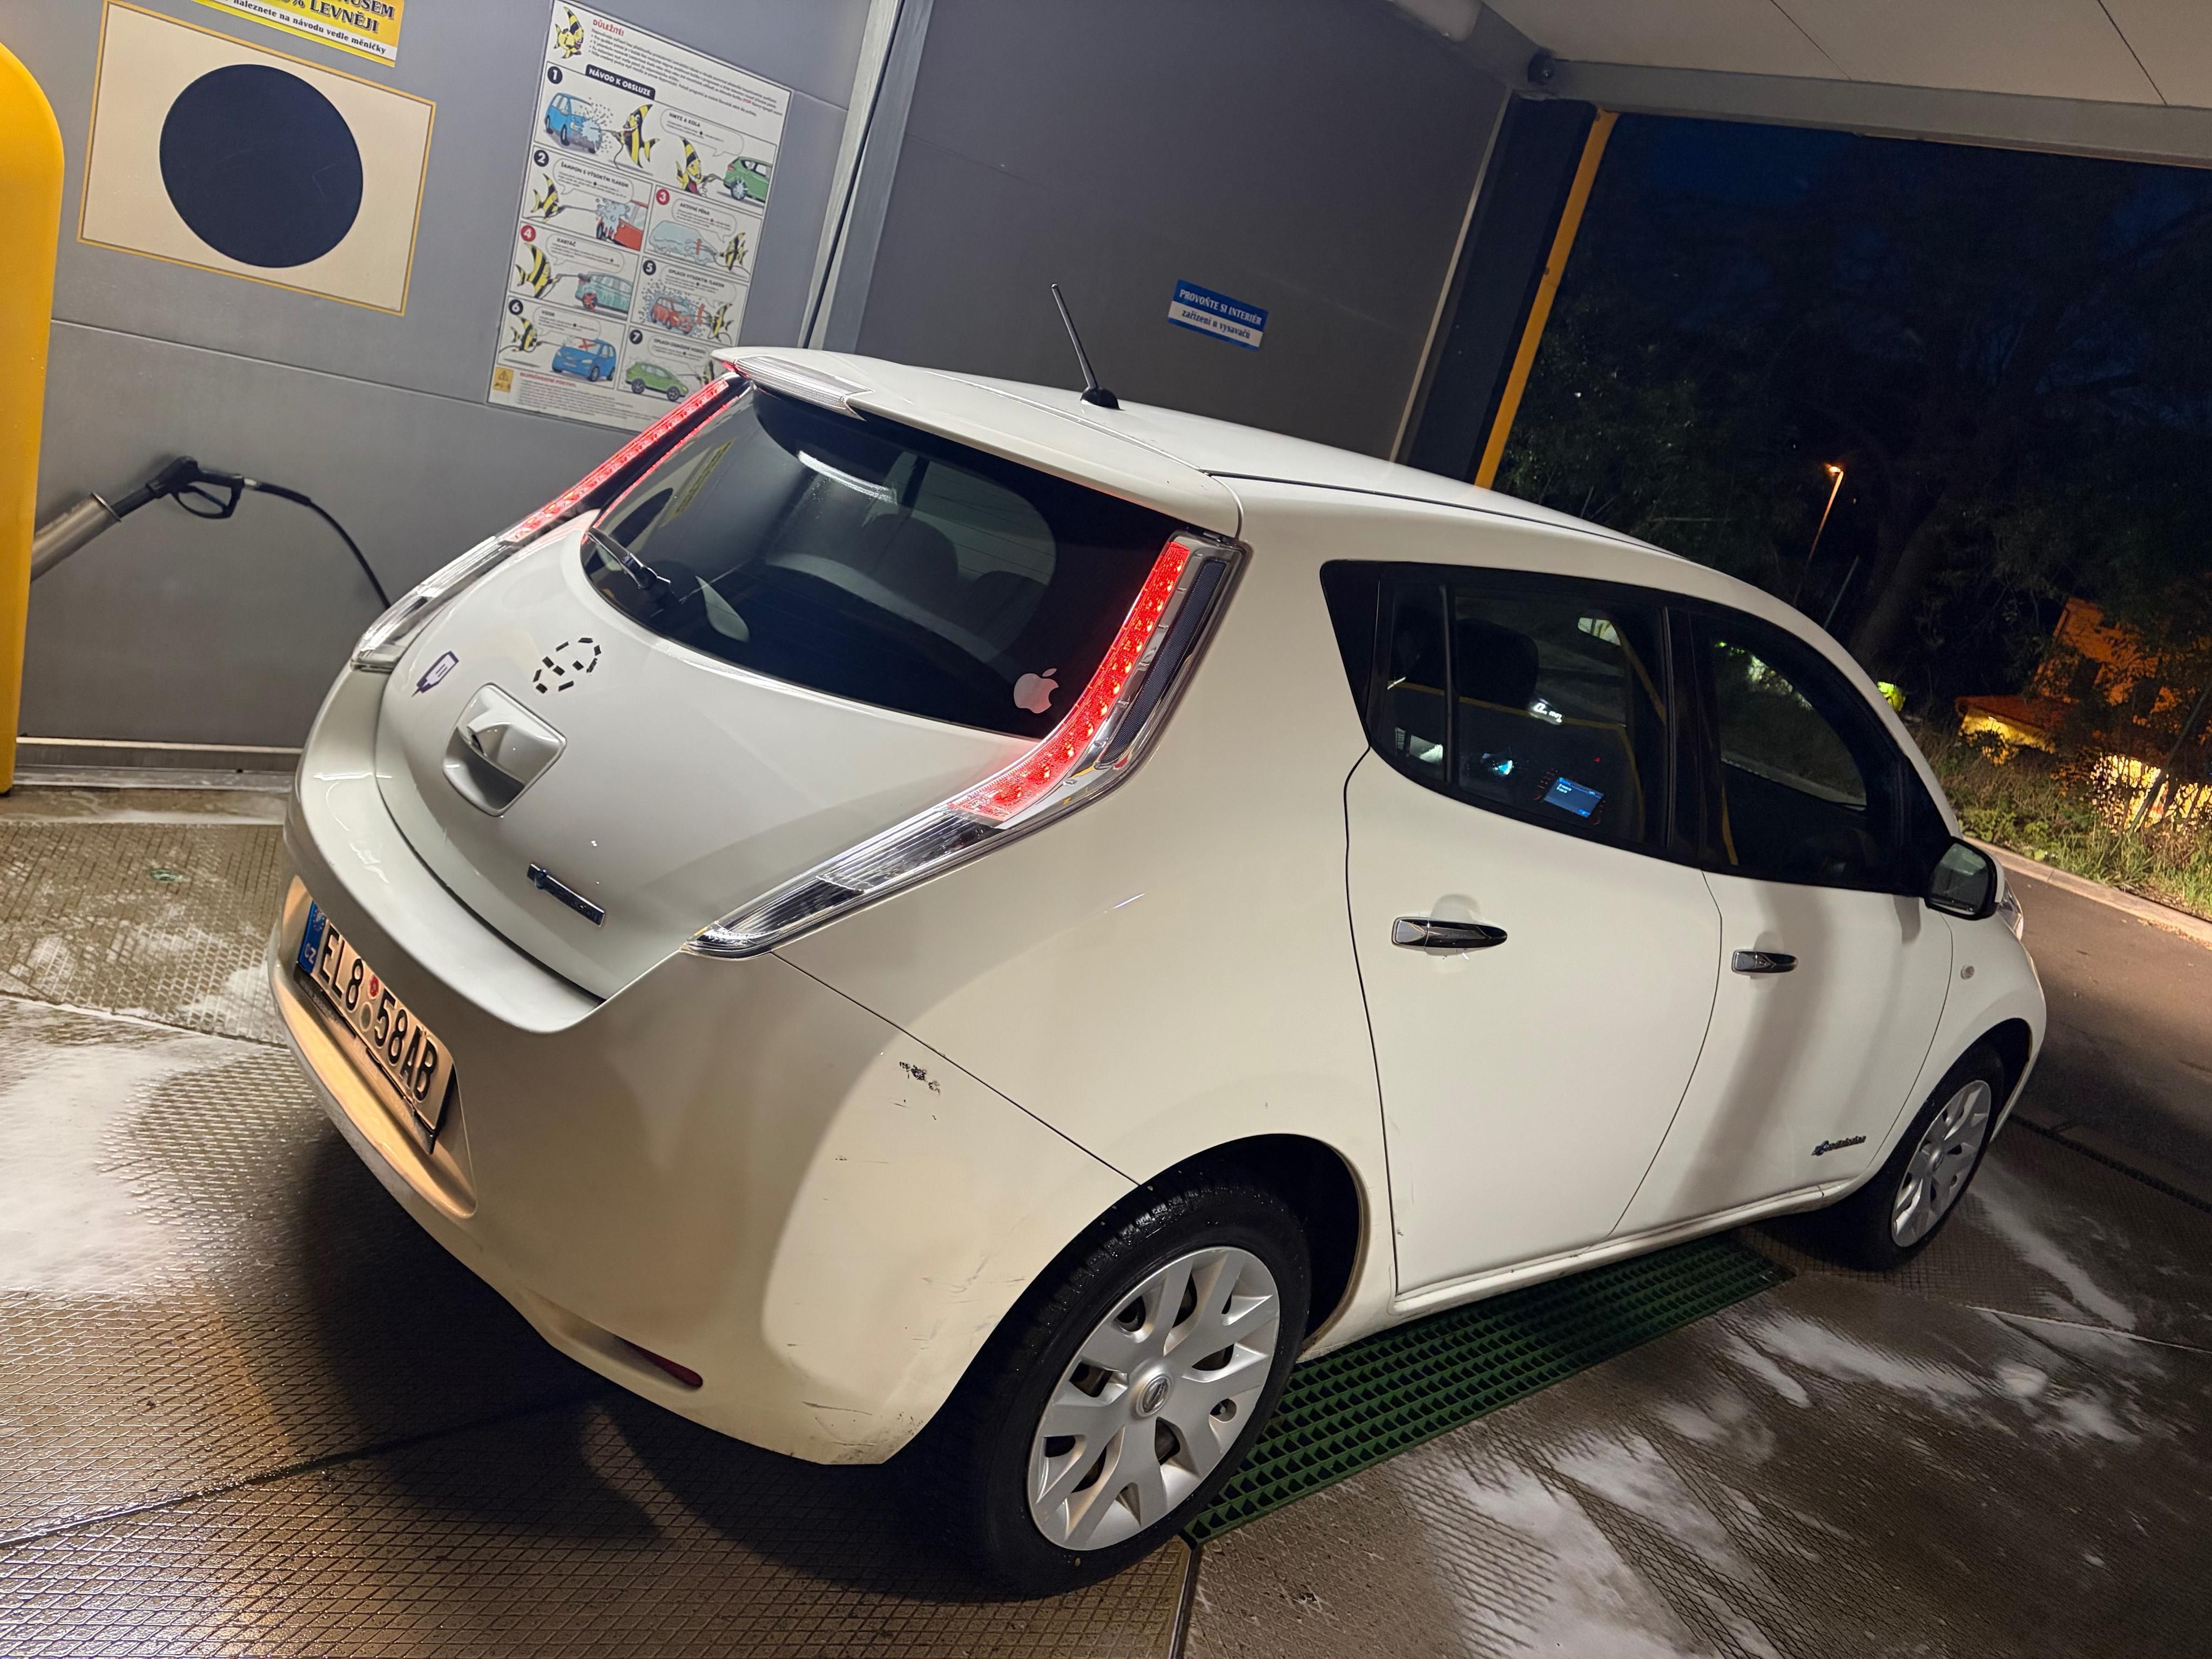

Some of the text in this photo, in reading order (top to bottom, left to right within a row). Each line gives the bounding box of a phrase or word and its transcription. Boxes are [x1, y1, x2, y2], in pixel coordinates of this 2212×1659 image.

[310, 0, 378, 32] LEVNĚJI
[338, 0, 394, 18] USEM
[233, 0, 276, 17] naleznete
[280, 14, 290, 22] na
[293, 18, 324, 32] návodu
[326, 29, 349, 41] vedle
[351, 37, 386, 54] měničky
[593, 19, 624, 36] DŮLEŽITÉ!
[552, 69, 558, 80] 1
[589, 68, 615, 82] NÁVOD
[622, 81, 651, 96] OBSLUZE
[537, 152, 545, 163] 2
[659, 191, 667, 203] 3
[523, 228, 532, 239] 4
[645, 262, 653, 273] 5
[512, 302, 520, 312] 6
[1179, 289, 1262, 325] PROVOŇTE SI INTERIÉR
[1182, 310, 1211, 325] zařízení
[1220, 322, 1251, 339] vysavačů
[632, 332, 640, 341] 7
[305, 942, 316, 965] CZ
[319, 924, 365, 1011] EL8
[374, 987, 438, 1102] 58AB
